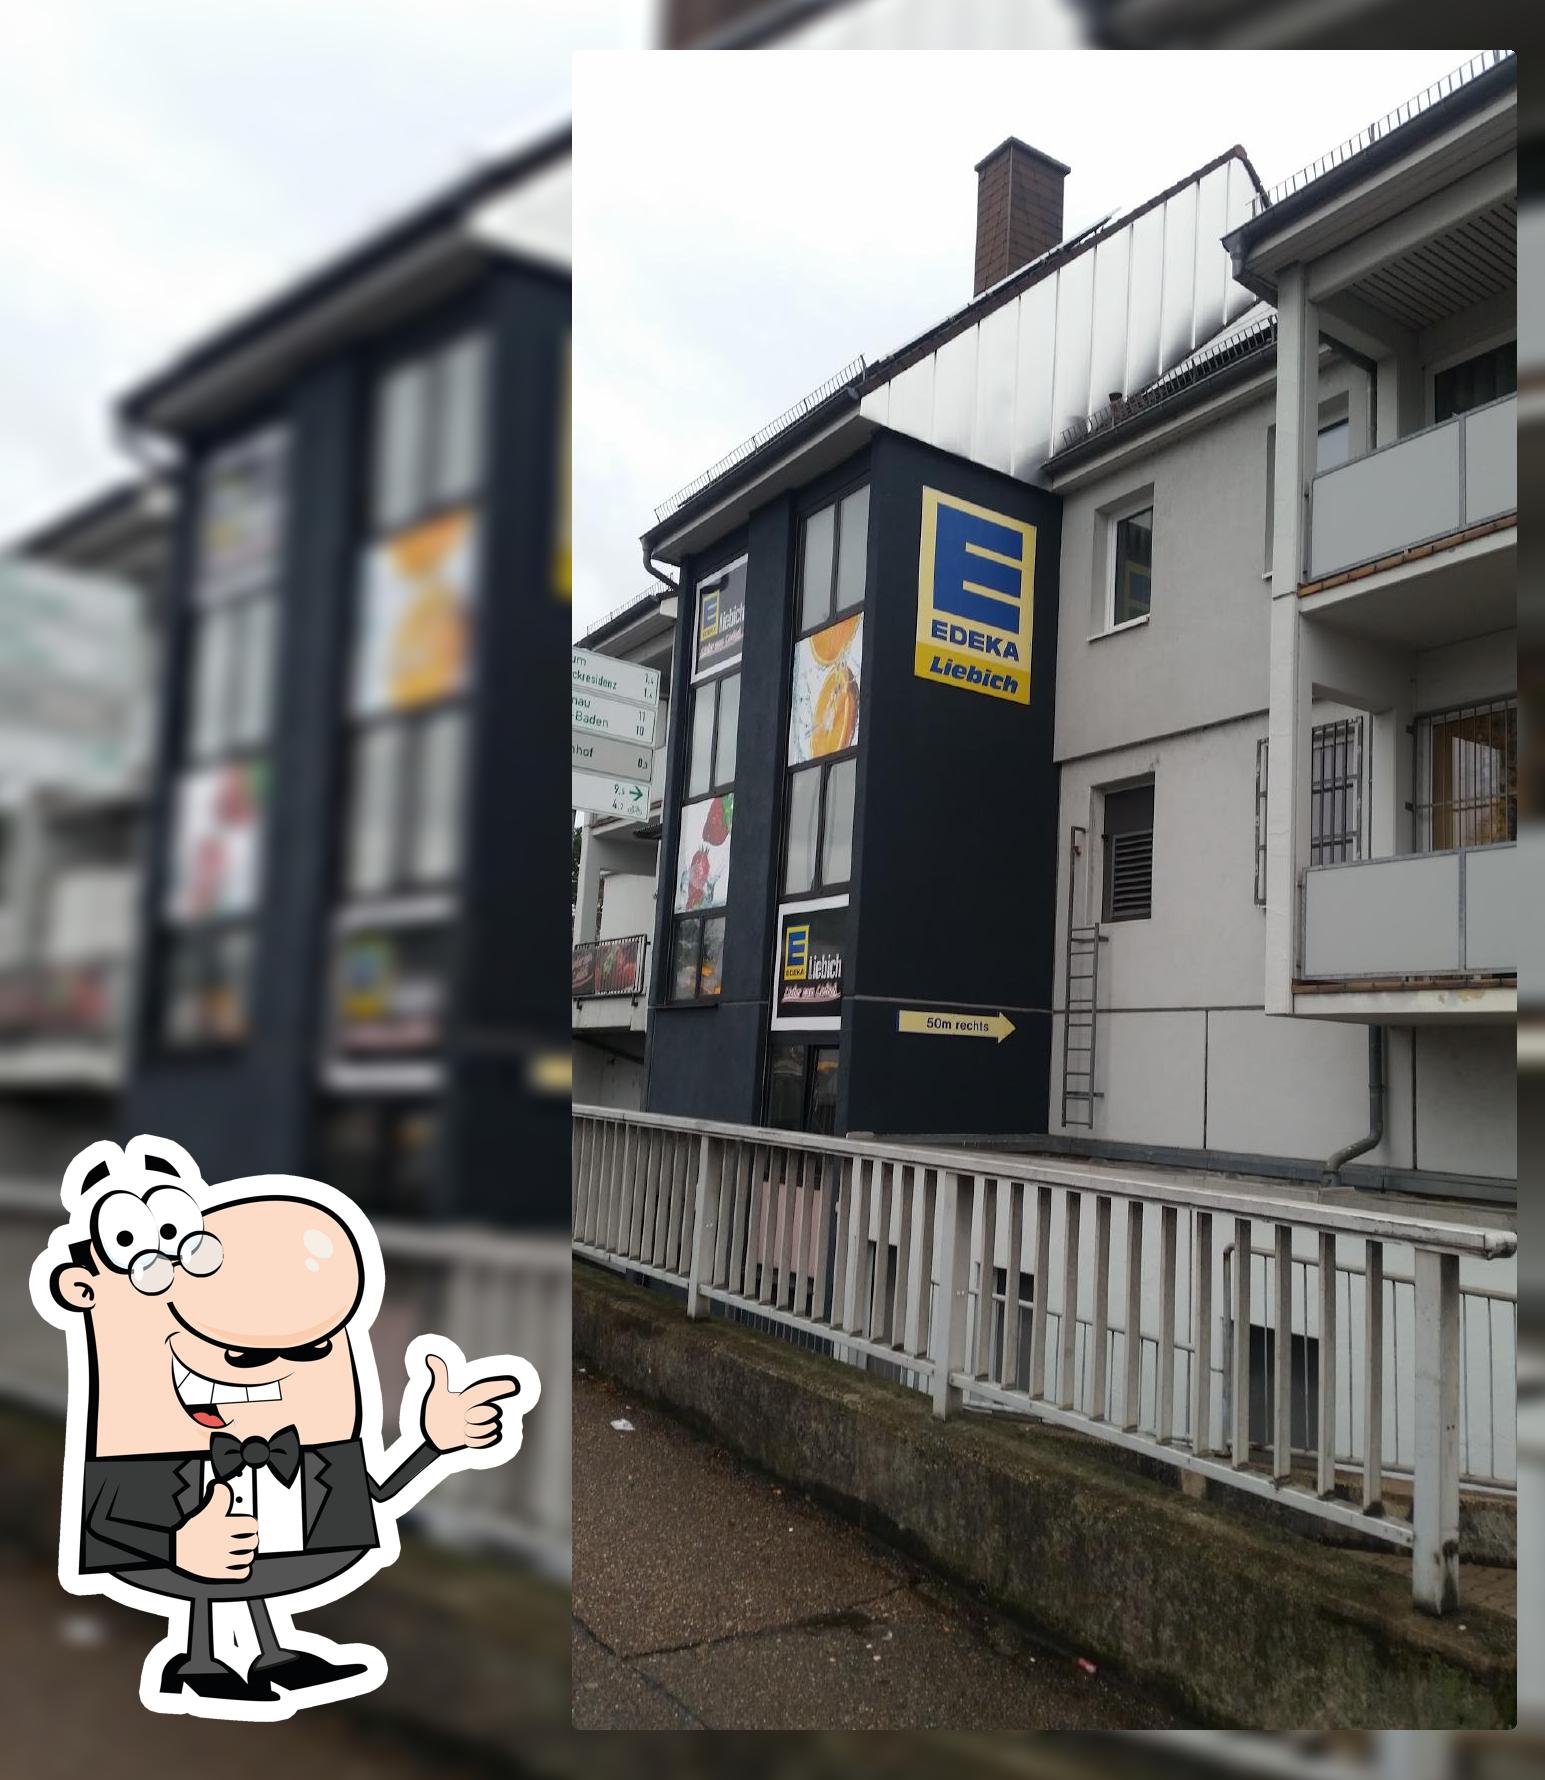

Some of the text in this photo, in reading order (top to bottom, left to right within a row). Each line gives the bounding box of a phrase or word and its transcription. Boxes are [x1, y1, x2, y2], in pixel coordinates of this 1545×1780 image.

[719, 602, 745, 632] Liebich
[931, 619, 1019, 661] EDEKA
[572, 670, 617, 690] ckresidenz
[929, 656, 1018, 694] Liebich
[807, 953, 842, 980] Liebich
[926, 1017, 989, 1032] 50m rechts
